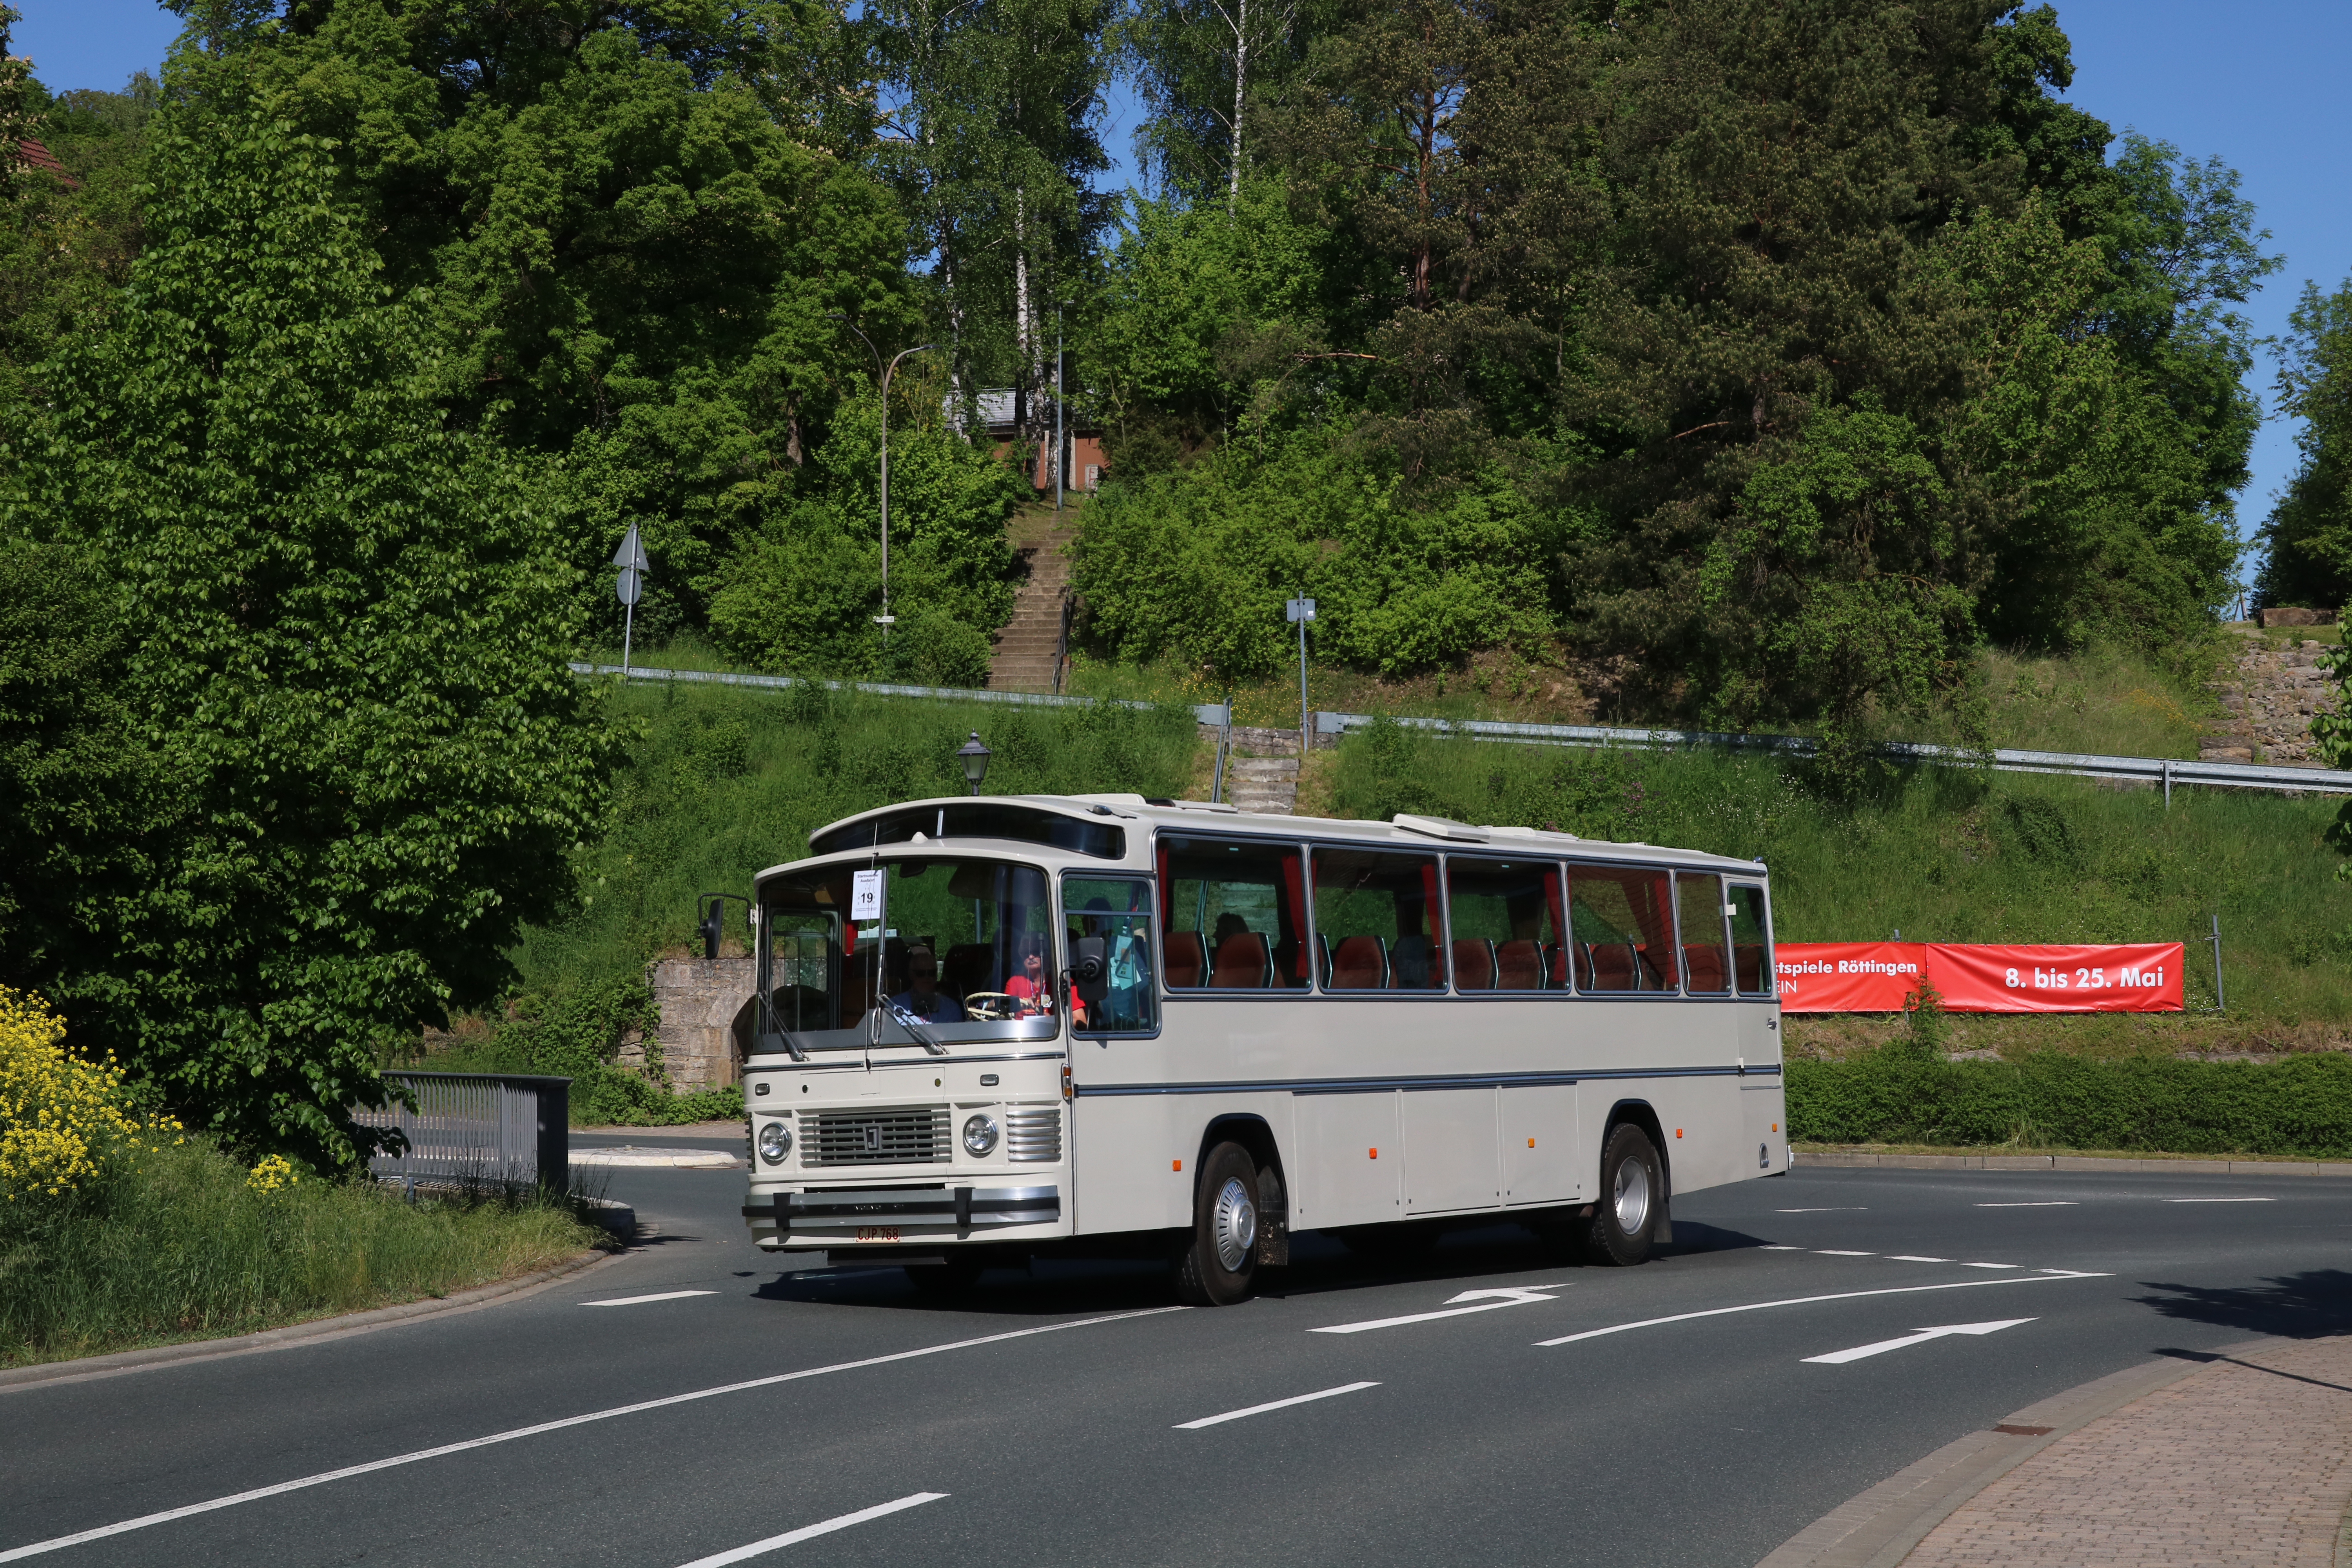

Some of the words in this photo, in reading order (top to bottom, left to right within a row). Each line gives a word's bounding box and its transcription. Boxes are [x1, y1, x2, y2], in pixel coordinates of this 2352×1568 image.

[861, 893, 873, 903] 19
[1776, 960, 1833, 976] tspiele
[1838, 960, 1916, 976] Röttingen
[2005, 968, 2026, 987] 8.
[2035, 967, 2068, 988] bis
[2076, 968, 2112, 988] 25.
[2120, 966, 2163, 987] Mai
